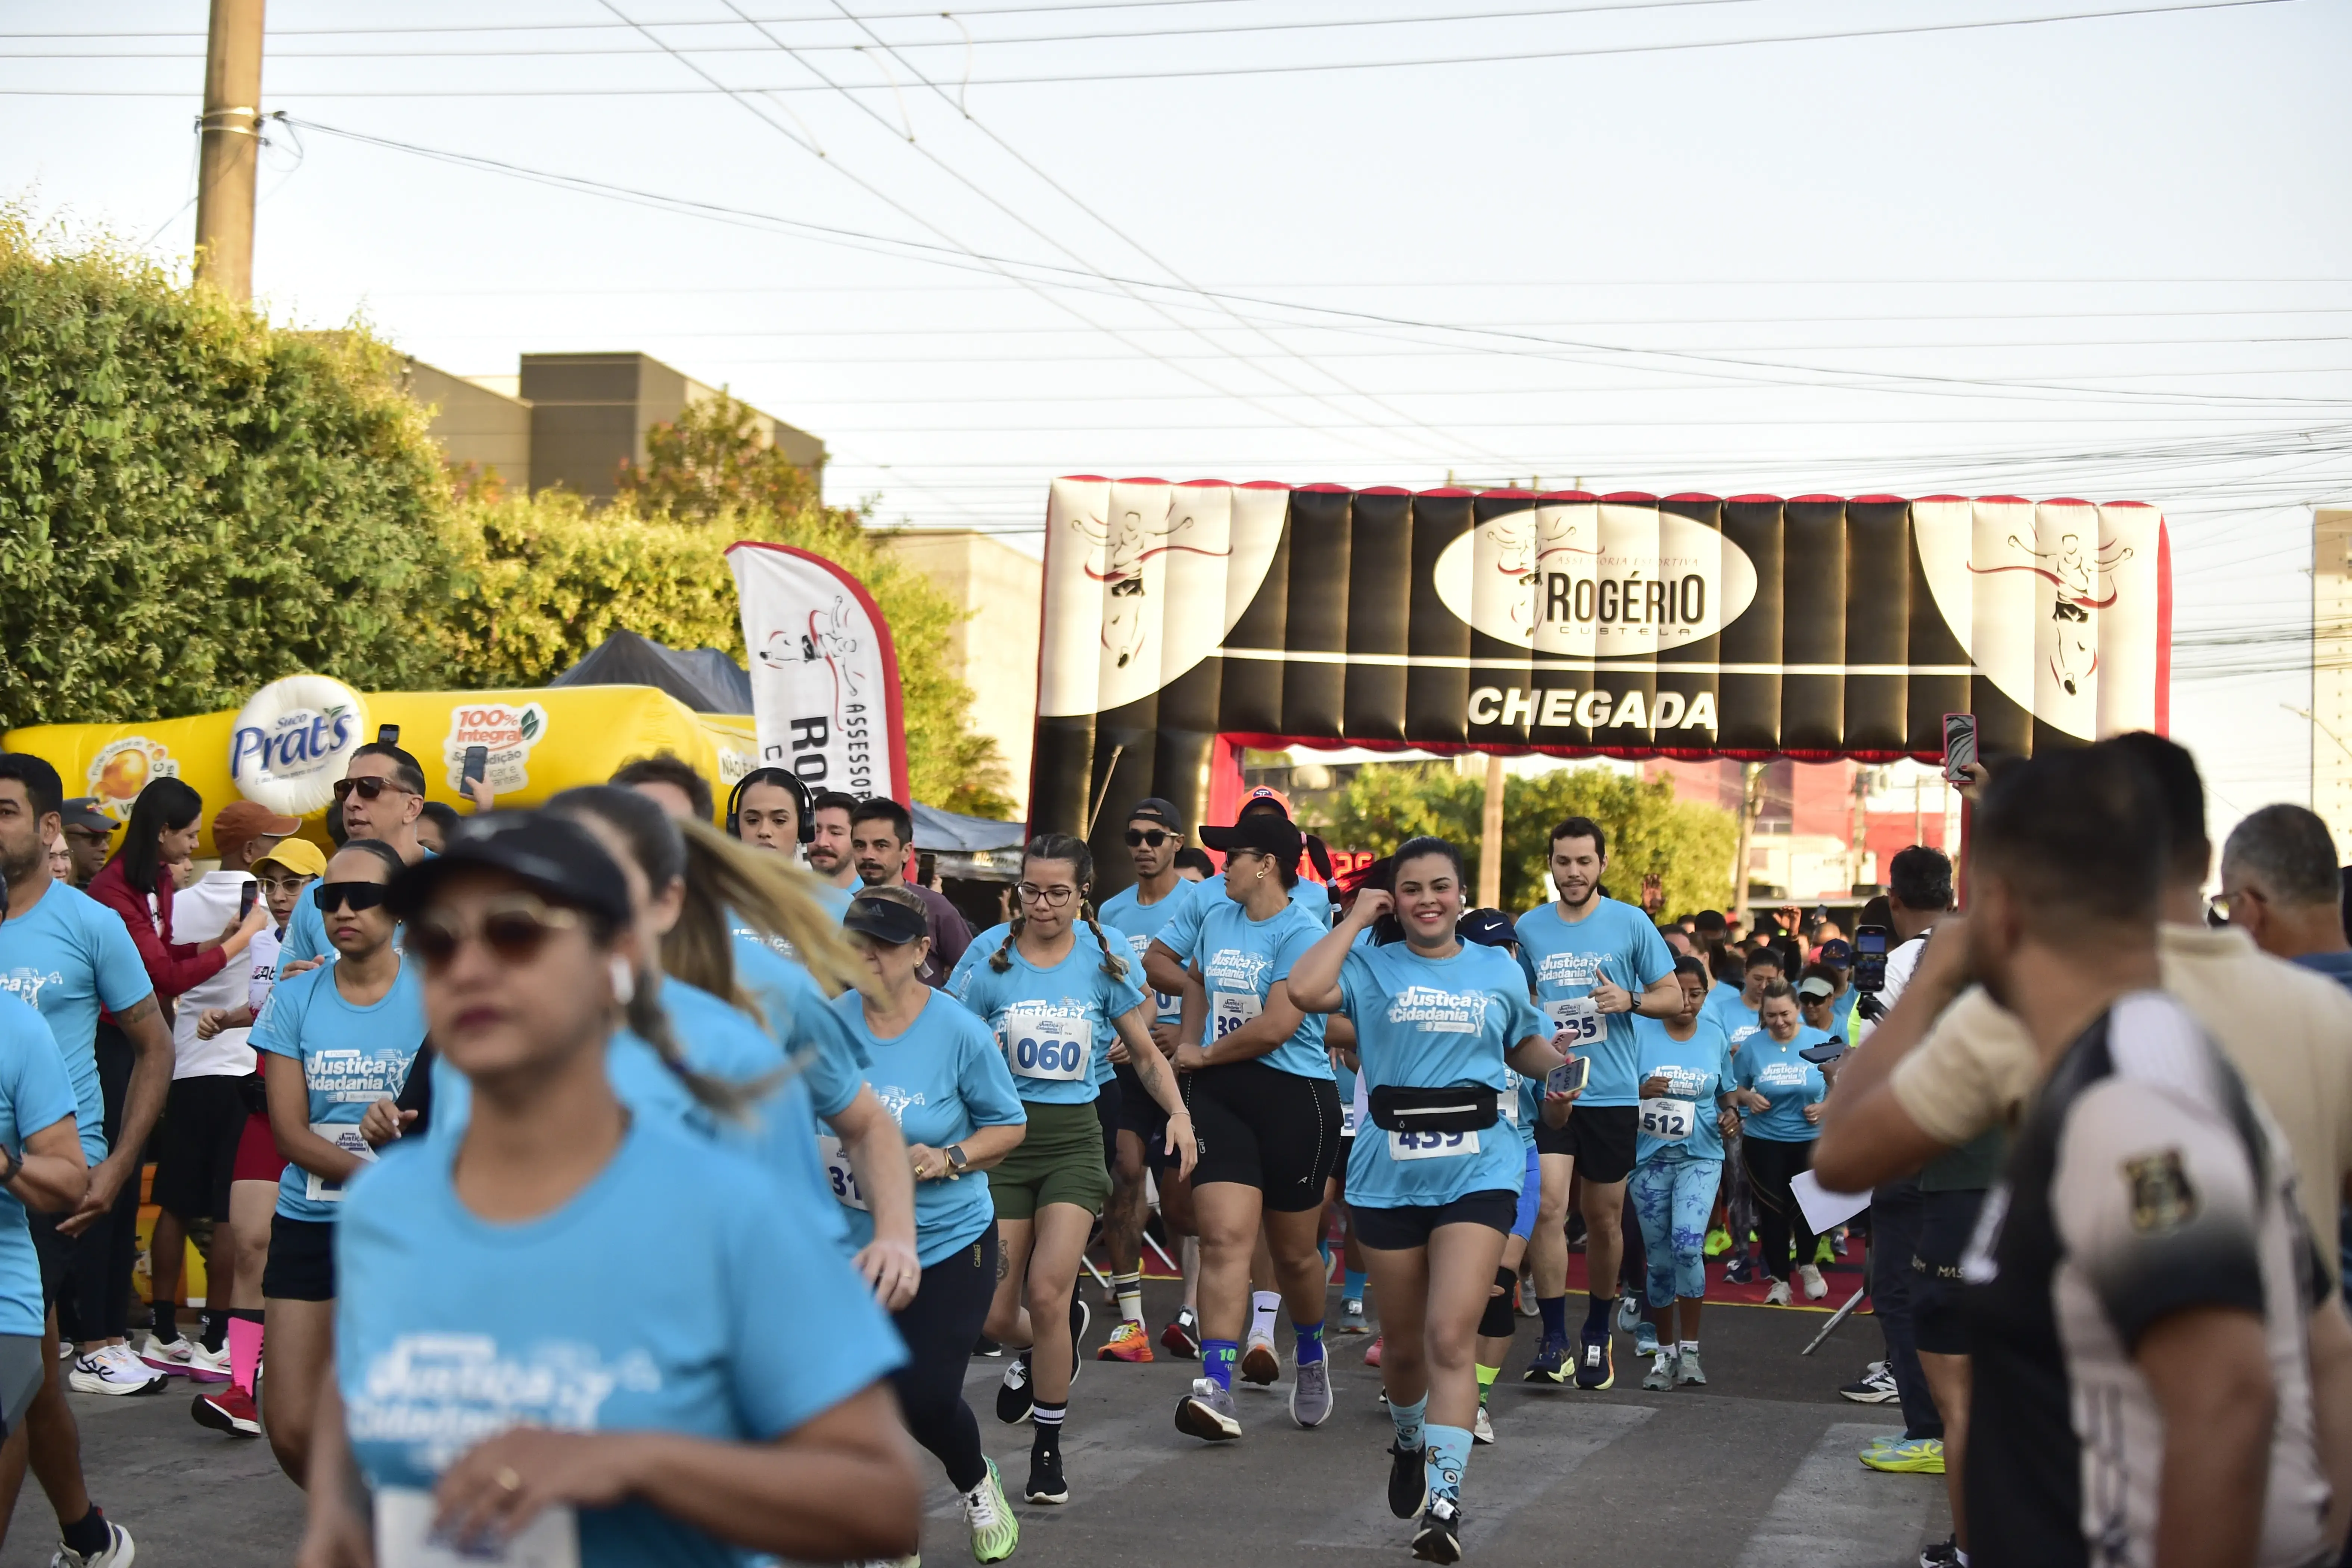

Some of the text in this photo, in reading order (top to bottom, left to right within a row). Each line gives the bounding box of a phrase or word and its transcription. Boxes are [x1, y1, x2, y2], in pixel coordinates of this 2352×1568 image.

[1547, 570, 1705, 625] ROGÉRIO
[1560, 626, 1692, 636] CUSTELA
[1468, 687, 1718, 730] CHEGADA
[276, 714, 307, 729] Suco
[460, 709, 519, 728] 100%
[457, 727, 523, 744] Integral
[1212, 949, 1251, 969] Justiça
[1541, 955, 1588, 971] Justiça
[1206, 966, 1245, 980] Cidadania
[1538, 968, 1586, 982] Cidadania
[1399, 986, 1472, 1009] Justiça
[1392, 1007, 1469, 1023] Cidadania
[1218, 1015, 1253, 1039] 39
[1017, 1037, 1080, 1072] 060
[307, 1050, 386, 1077] Justiça
[1763, 1065, 1798, 1076] Justiça
[306, 1075, 383, 1091] Cidadania
[1759, 1074, 1797, 1082] Cidadania
[1643, 1113, 1684, 1136] 512
